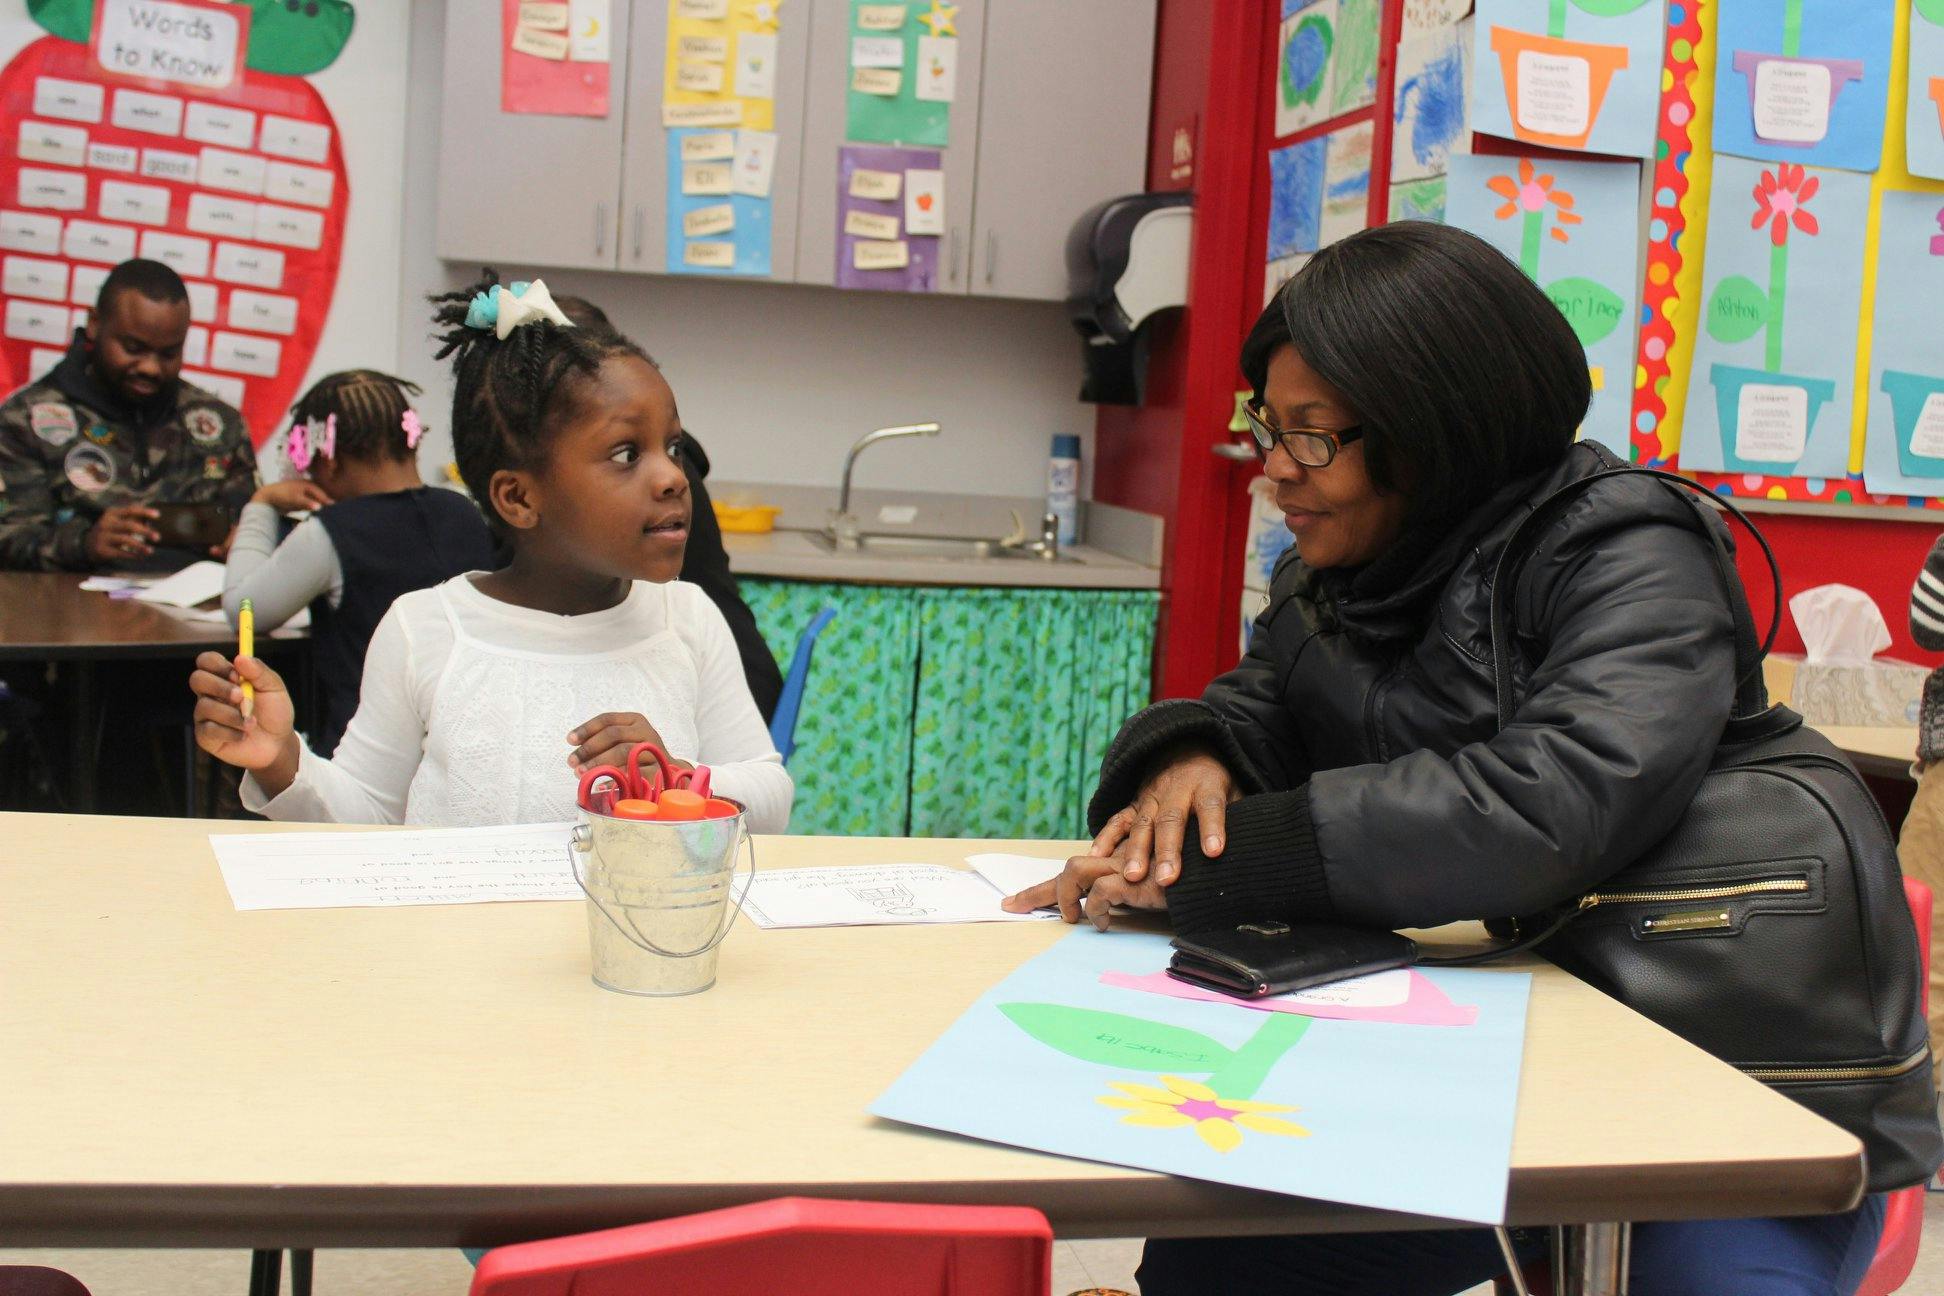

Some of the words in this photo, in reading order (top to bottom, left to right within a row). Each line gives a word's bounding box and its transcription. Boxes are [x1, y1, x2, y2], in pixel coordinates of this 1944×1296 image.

[127, 3, 215, 42] Words
[113, 42, 142, 67] to
[149, 47, 224, 78] Know
[1652, 918, 1690, 927] CHRISTIAN
